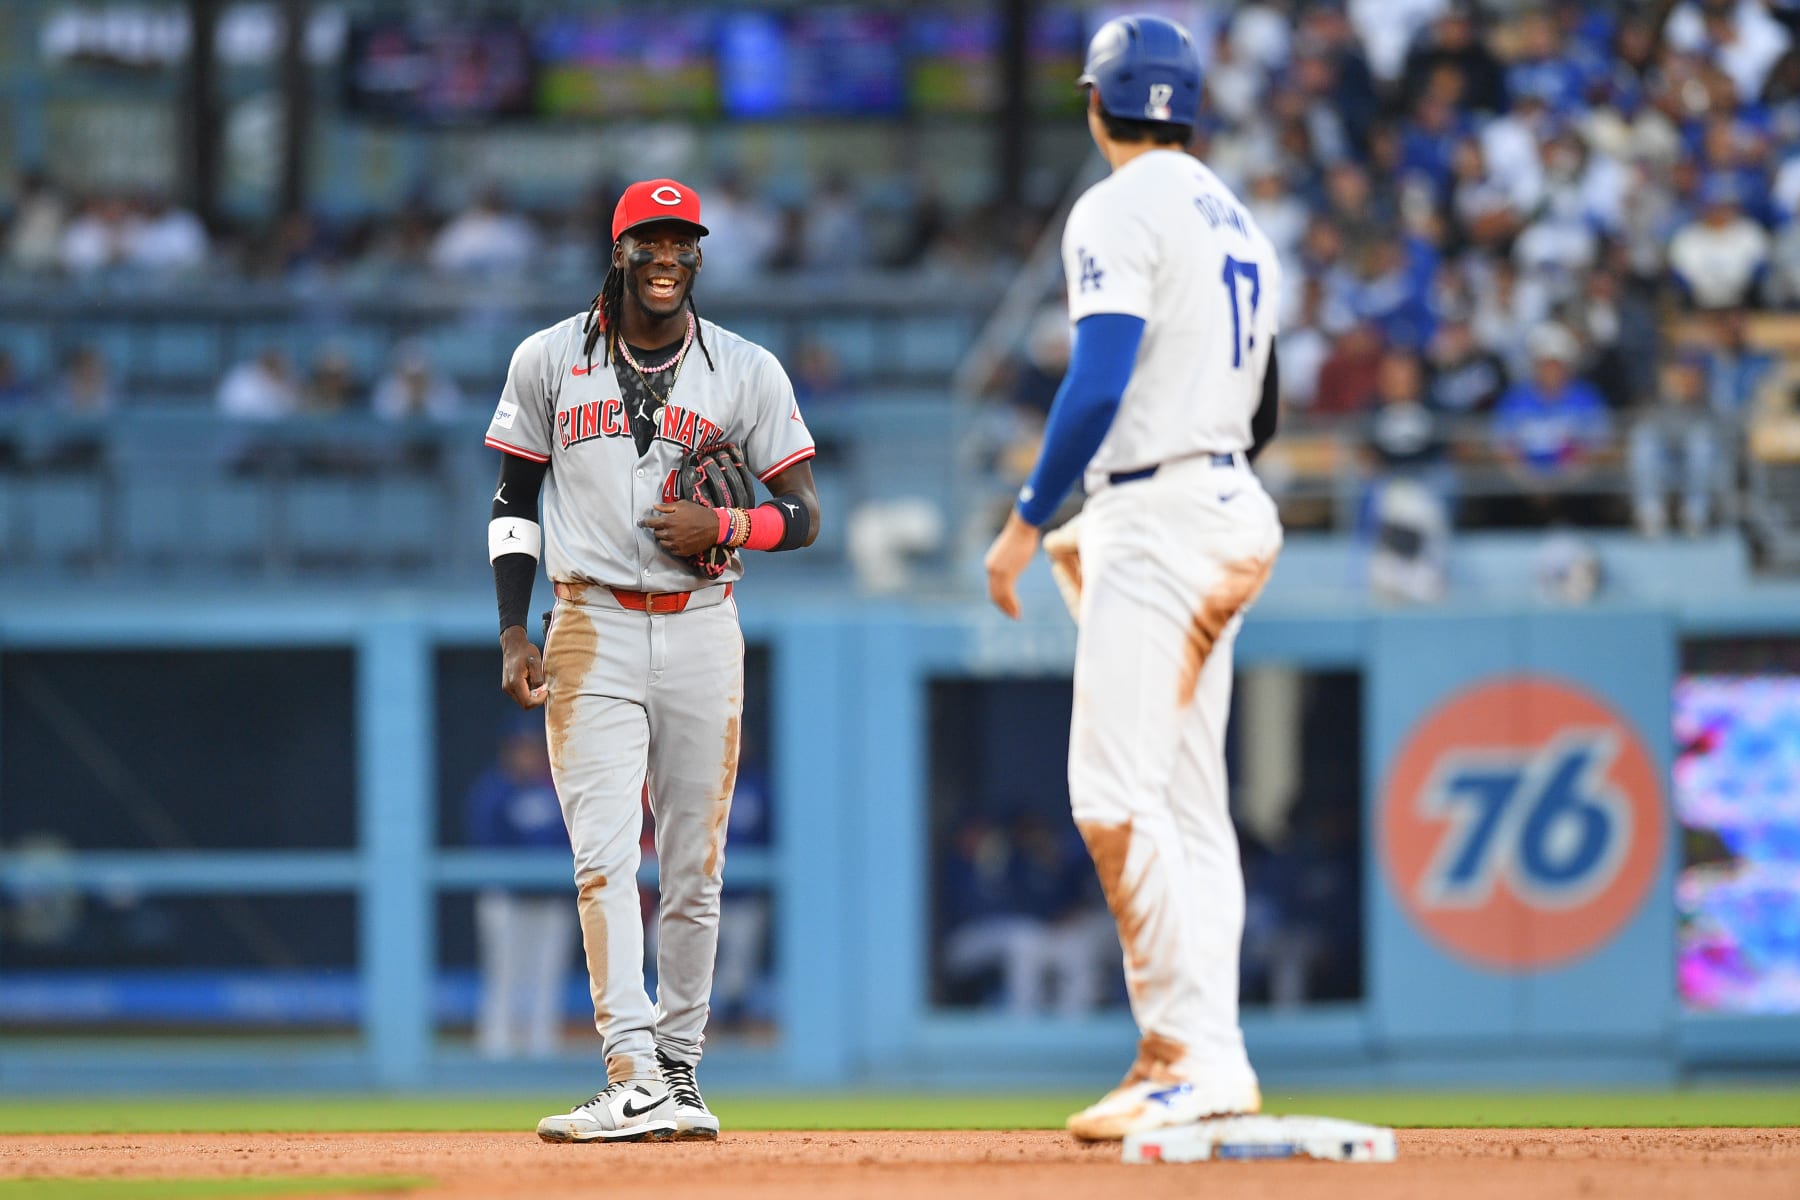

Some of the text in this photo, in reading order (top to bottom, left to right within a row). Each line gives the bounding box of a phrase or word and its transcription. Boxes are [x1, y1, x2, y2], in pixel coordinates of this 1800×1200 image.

[650, 185, 682, 206] C
[1077, 247, 1105, 294] LA
[1222, 253, 1260, 368] 17
[495, 409, 512, 421] ger
[556, 398, 725, 452] CINCINATI
[1421, 728, 1632, 908] 76
